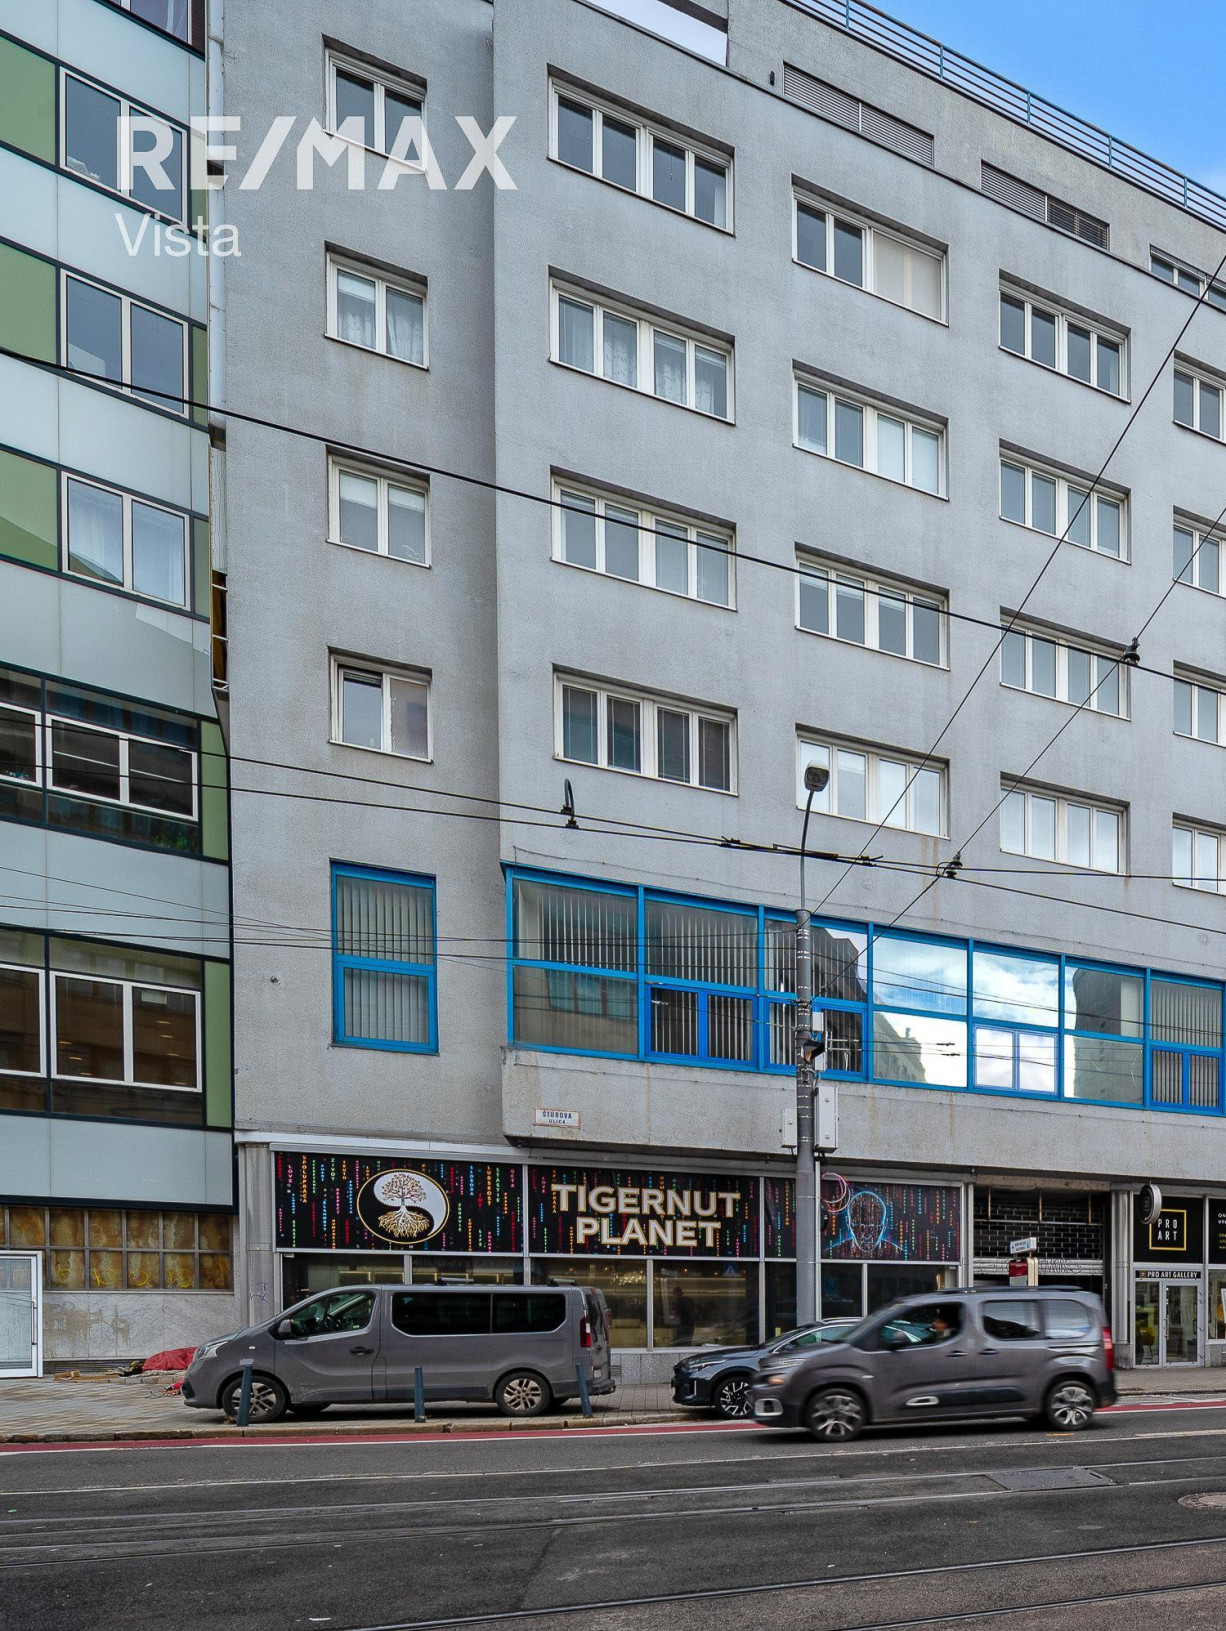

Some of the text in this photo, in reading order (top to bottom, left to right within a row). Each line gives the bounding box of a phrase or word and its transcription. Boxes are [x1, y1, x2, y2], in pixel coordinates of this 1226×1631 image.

[551, 1183, 741, 1218] TIGERNUT
[575, 1216, 722, 1247] PLANET
[1157, 1219, 1178, 1229] PRO
[1157, 1231, 1178, 1240] ART
